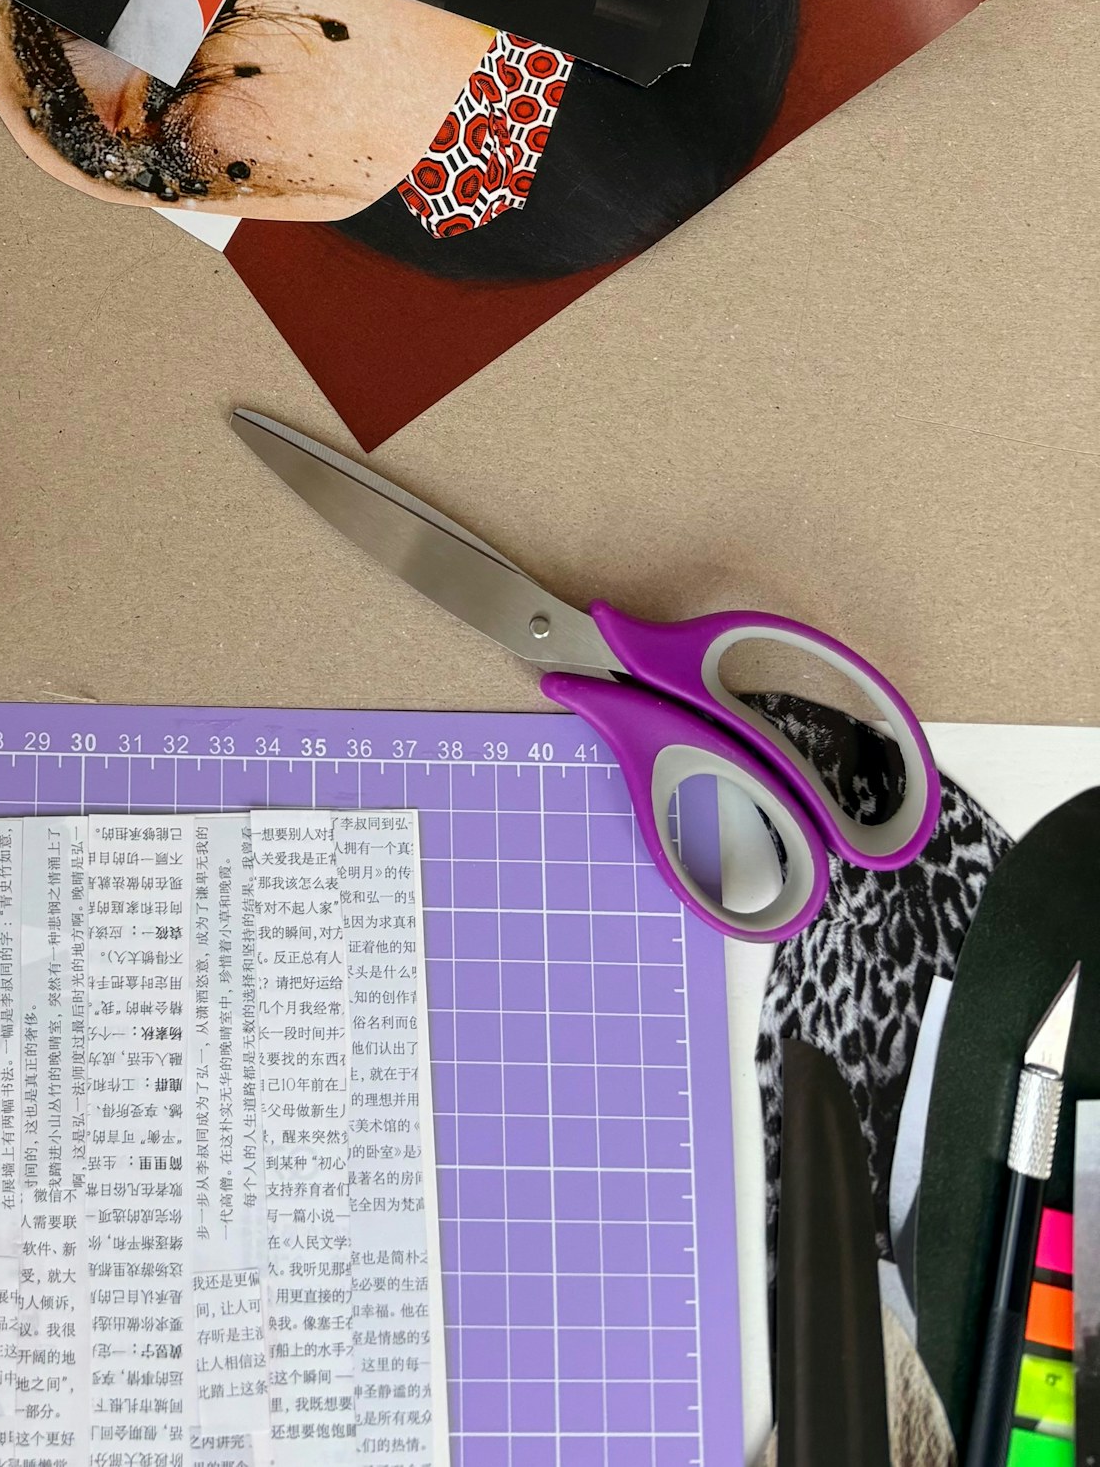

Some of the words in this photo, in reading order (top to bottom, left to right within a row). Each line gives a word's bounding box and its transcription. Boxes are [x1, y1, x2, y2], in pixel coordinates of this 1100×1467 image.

[23, 731, 51, 751] 29
[70, 732, 97, 752] 30
[118, 733, 142, 753] 31
[163, 734, 189, 754] 32
[209, 735, 235, 755] 33
[255, 736, 281, 756] 34
[300, 737, 327, 757] 35
[346, 738, 373, 758] 36
[392, 739, 418, 759] 37
[437, 740, 464, 760] 38
[483, 741, 509, 761] 39
[527, 742, 554, 762] 40
[574, 743, 598, 763] 41
